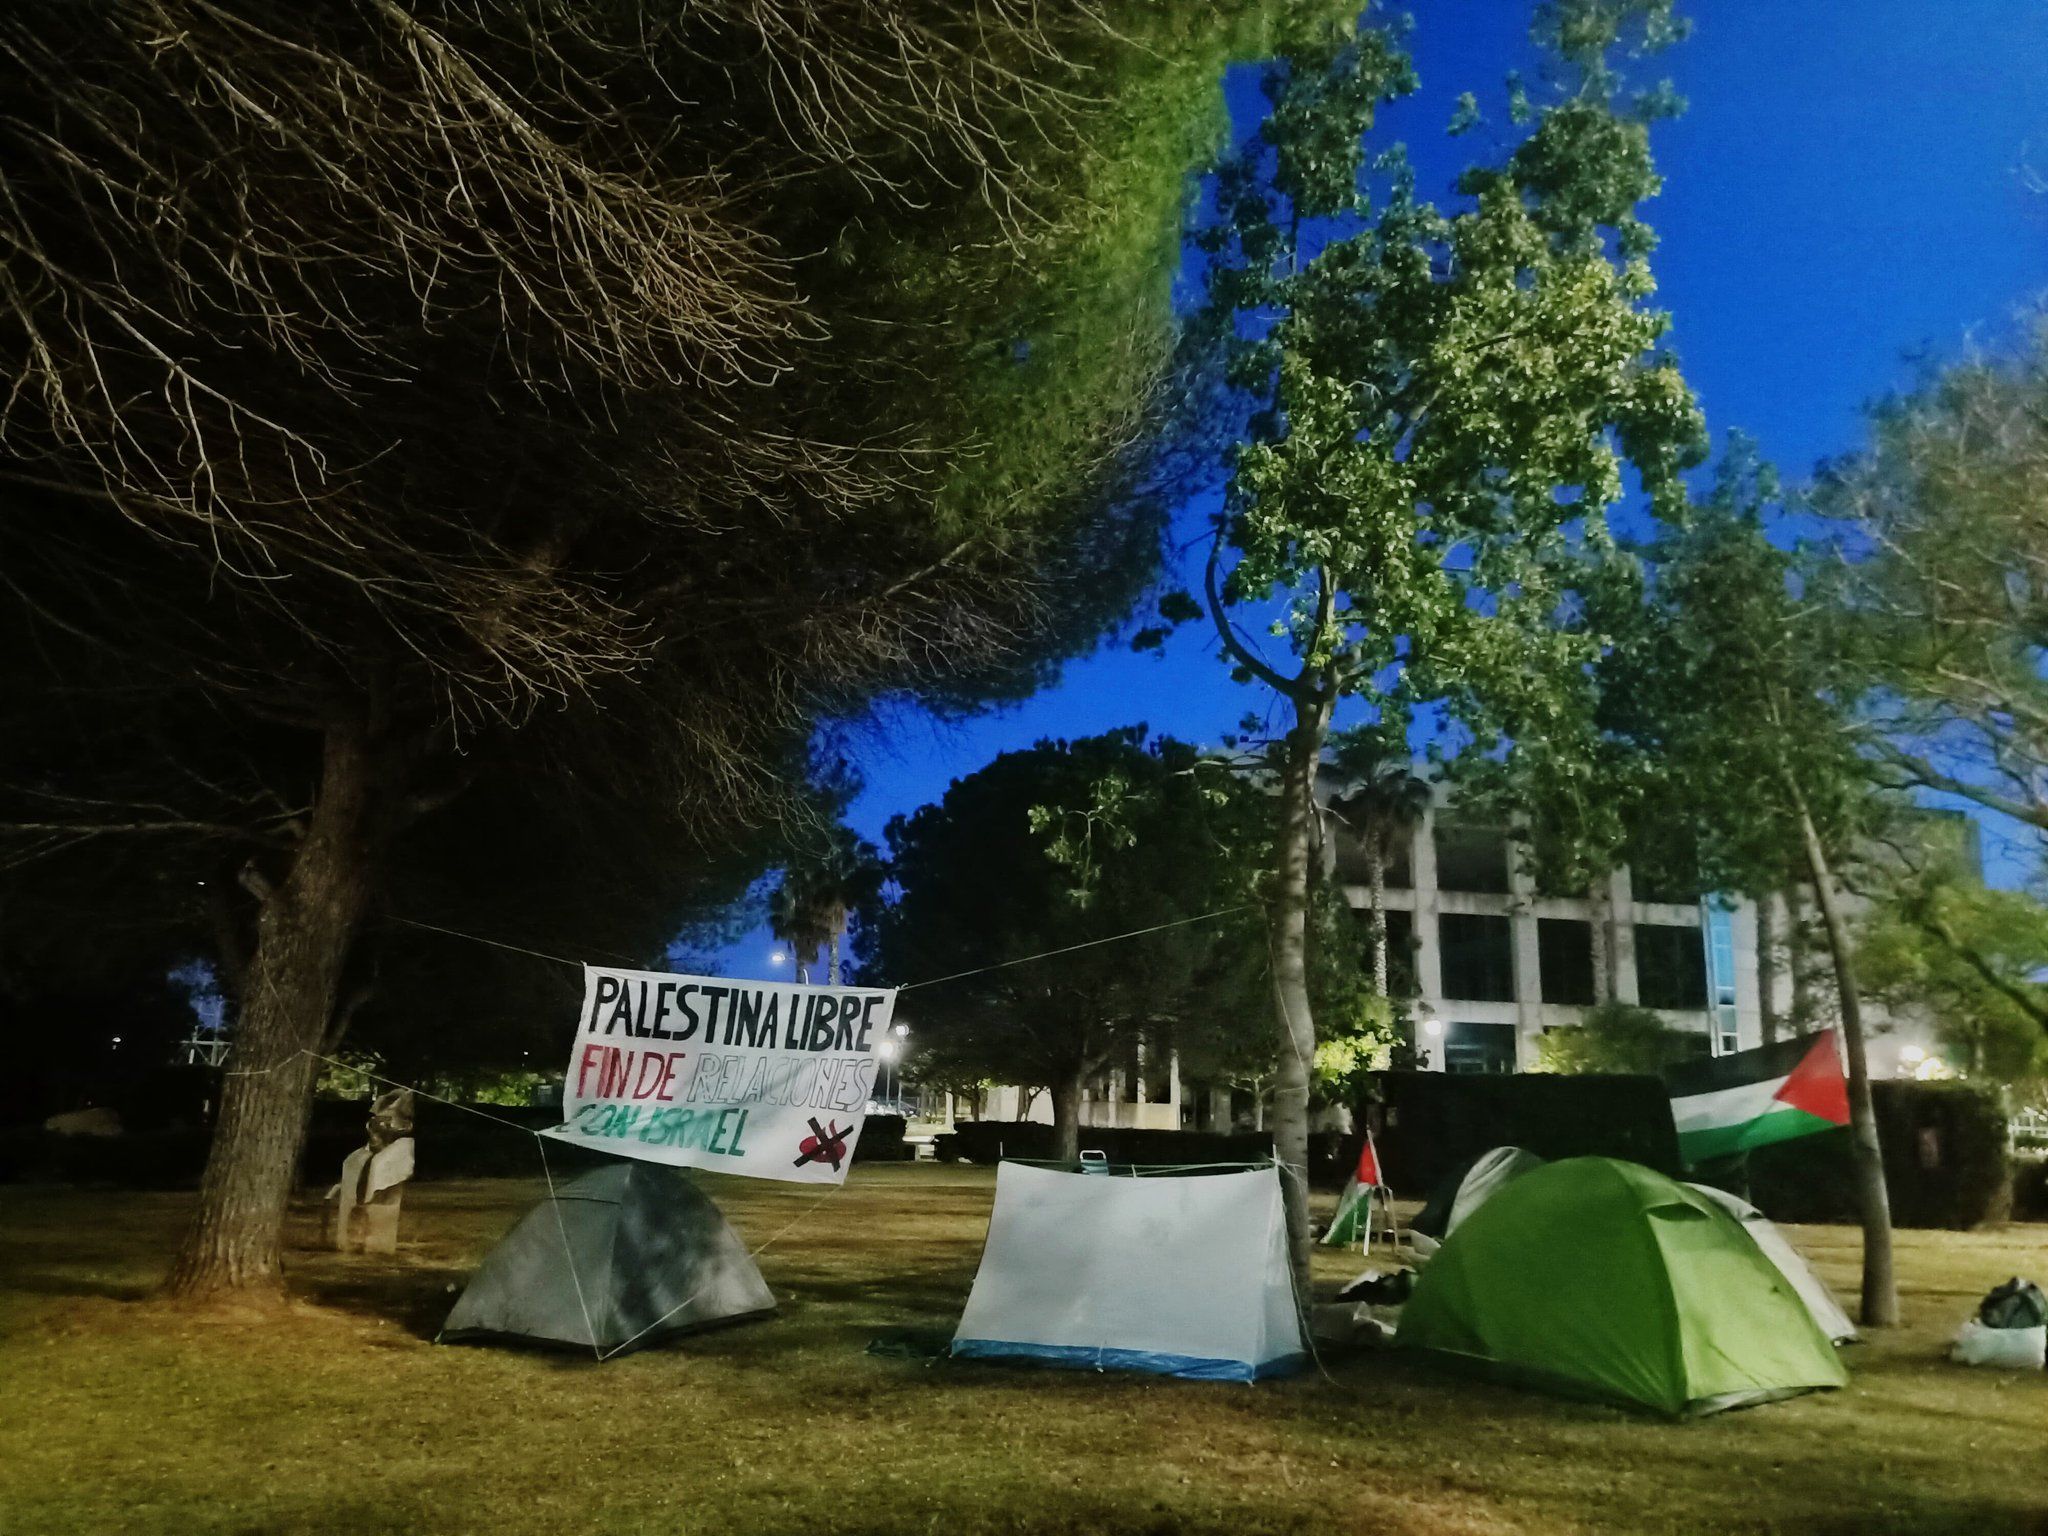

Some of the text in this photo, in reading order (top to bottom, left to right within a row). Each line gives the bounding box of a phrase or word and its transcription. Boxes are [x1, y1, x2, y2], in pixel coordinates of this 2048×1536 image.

[588, 976, 885, 1052] PALESTINA LIBRE
[576, 1043, 874, 1113] FIN DE RELACIONES
[638, 1107, 749, 1157] ISRAEL
